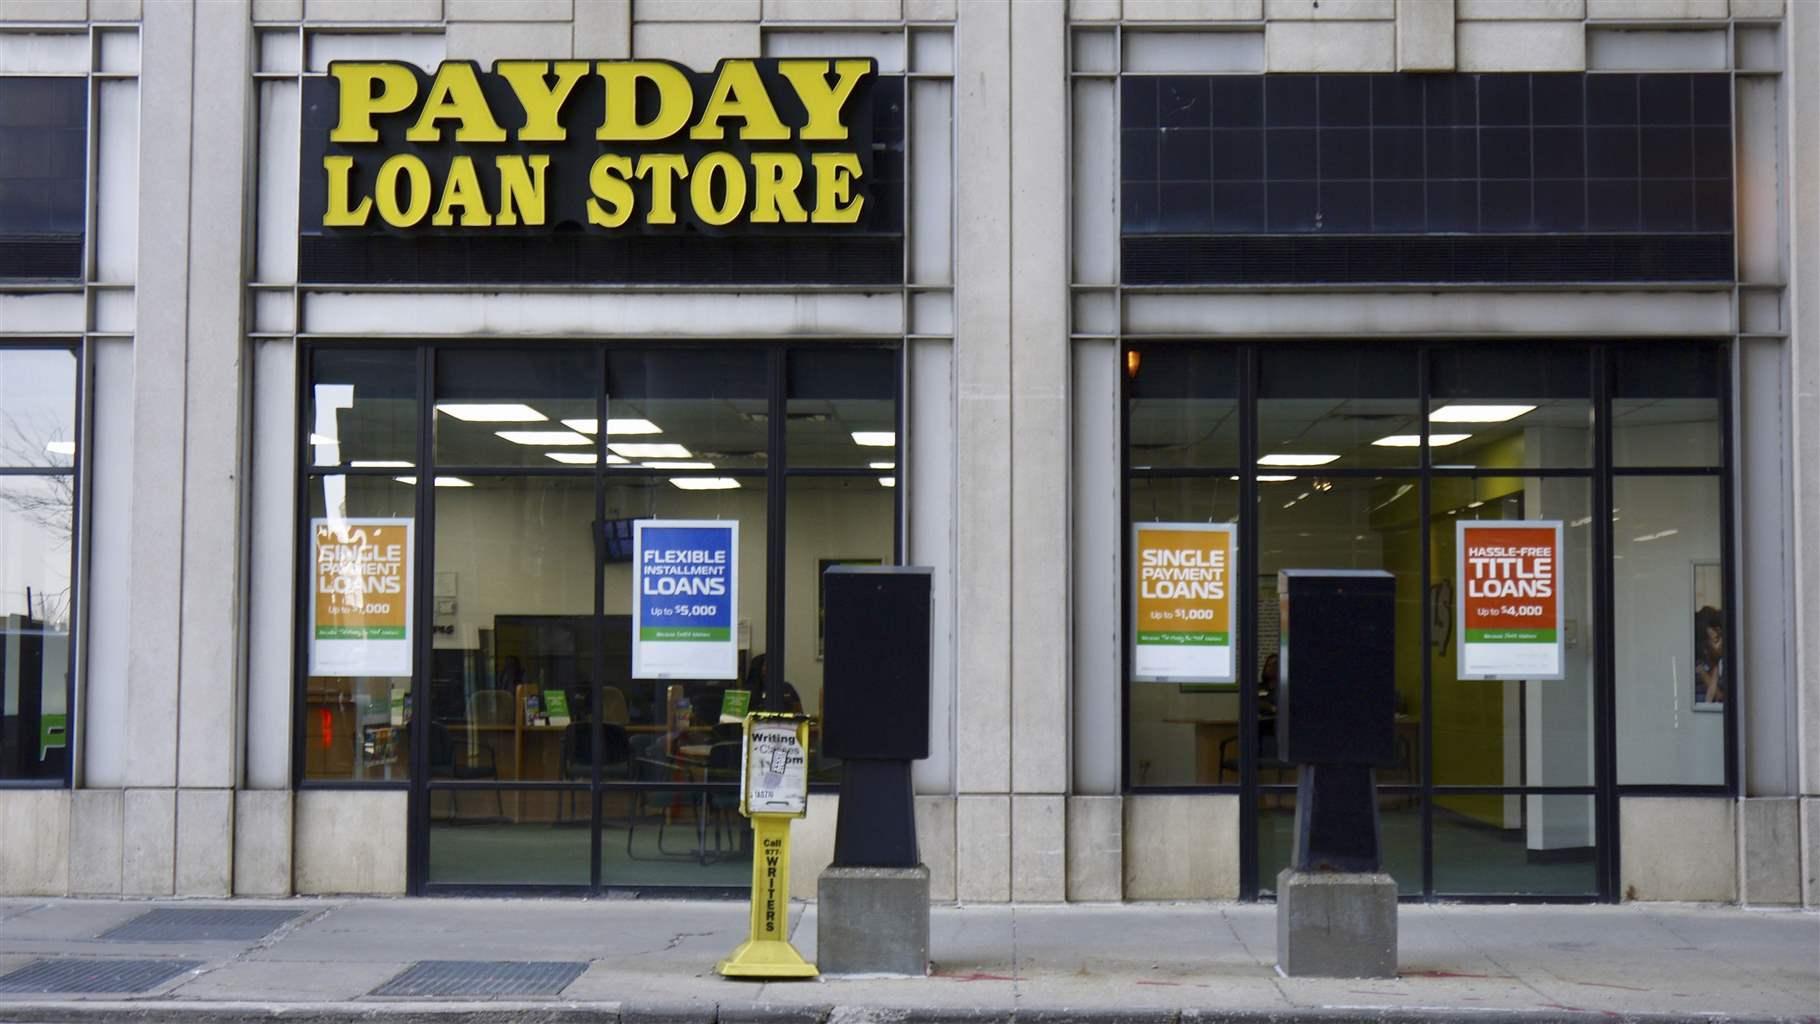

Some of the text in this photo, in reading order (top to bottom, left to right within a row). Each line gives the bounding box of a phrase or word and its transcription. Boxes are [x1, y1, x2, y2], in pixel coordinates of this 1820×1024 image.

[329, 60, 872, 143] PAYDAY
[322, 150, 866, 228] LOAN STORE
[644, 550, 726, 563] FLEXIBLE
[1142, 549, 1224, 566] SINGLE
[1469, 548, 1552, 557] HASSLE-FREE
[320, 563, 400, 576] PAMENT
[644, 566, 725, 575] INSTALLMENT
[1142, 568, 1224, 581] PAYMENT
[1469, 558, 1552, 578] TITLE
[320, 577, 401, 593] LOANS
[644, 578, 726, 595] LOANS
[1142, 582, 1224, 599] LOANS
[1469, 580, 1552, 598] LOANS
[651, 608, 662, 616] Up
[674, 605, 717, 616] $5,000
[1174, 609, 1214, 620] $1,000
[1477, 608, 1489, 616] Up
[1501, 606, 1543, 616] $4,000
[752, 733, 795, 744] Writing
[766, 857, 779, 932] WRITERS
